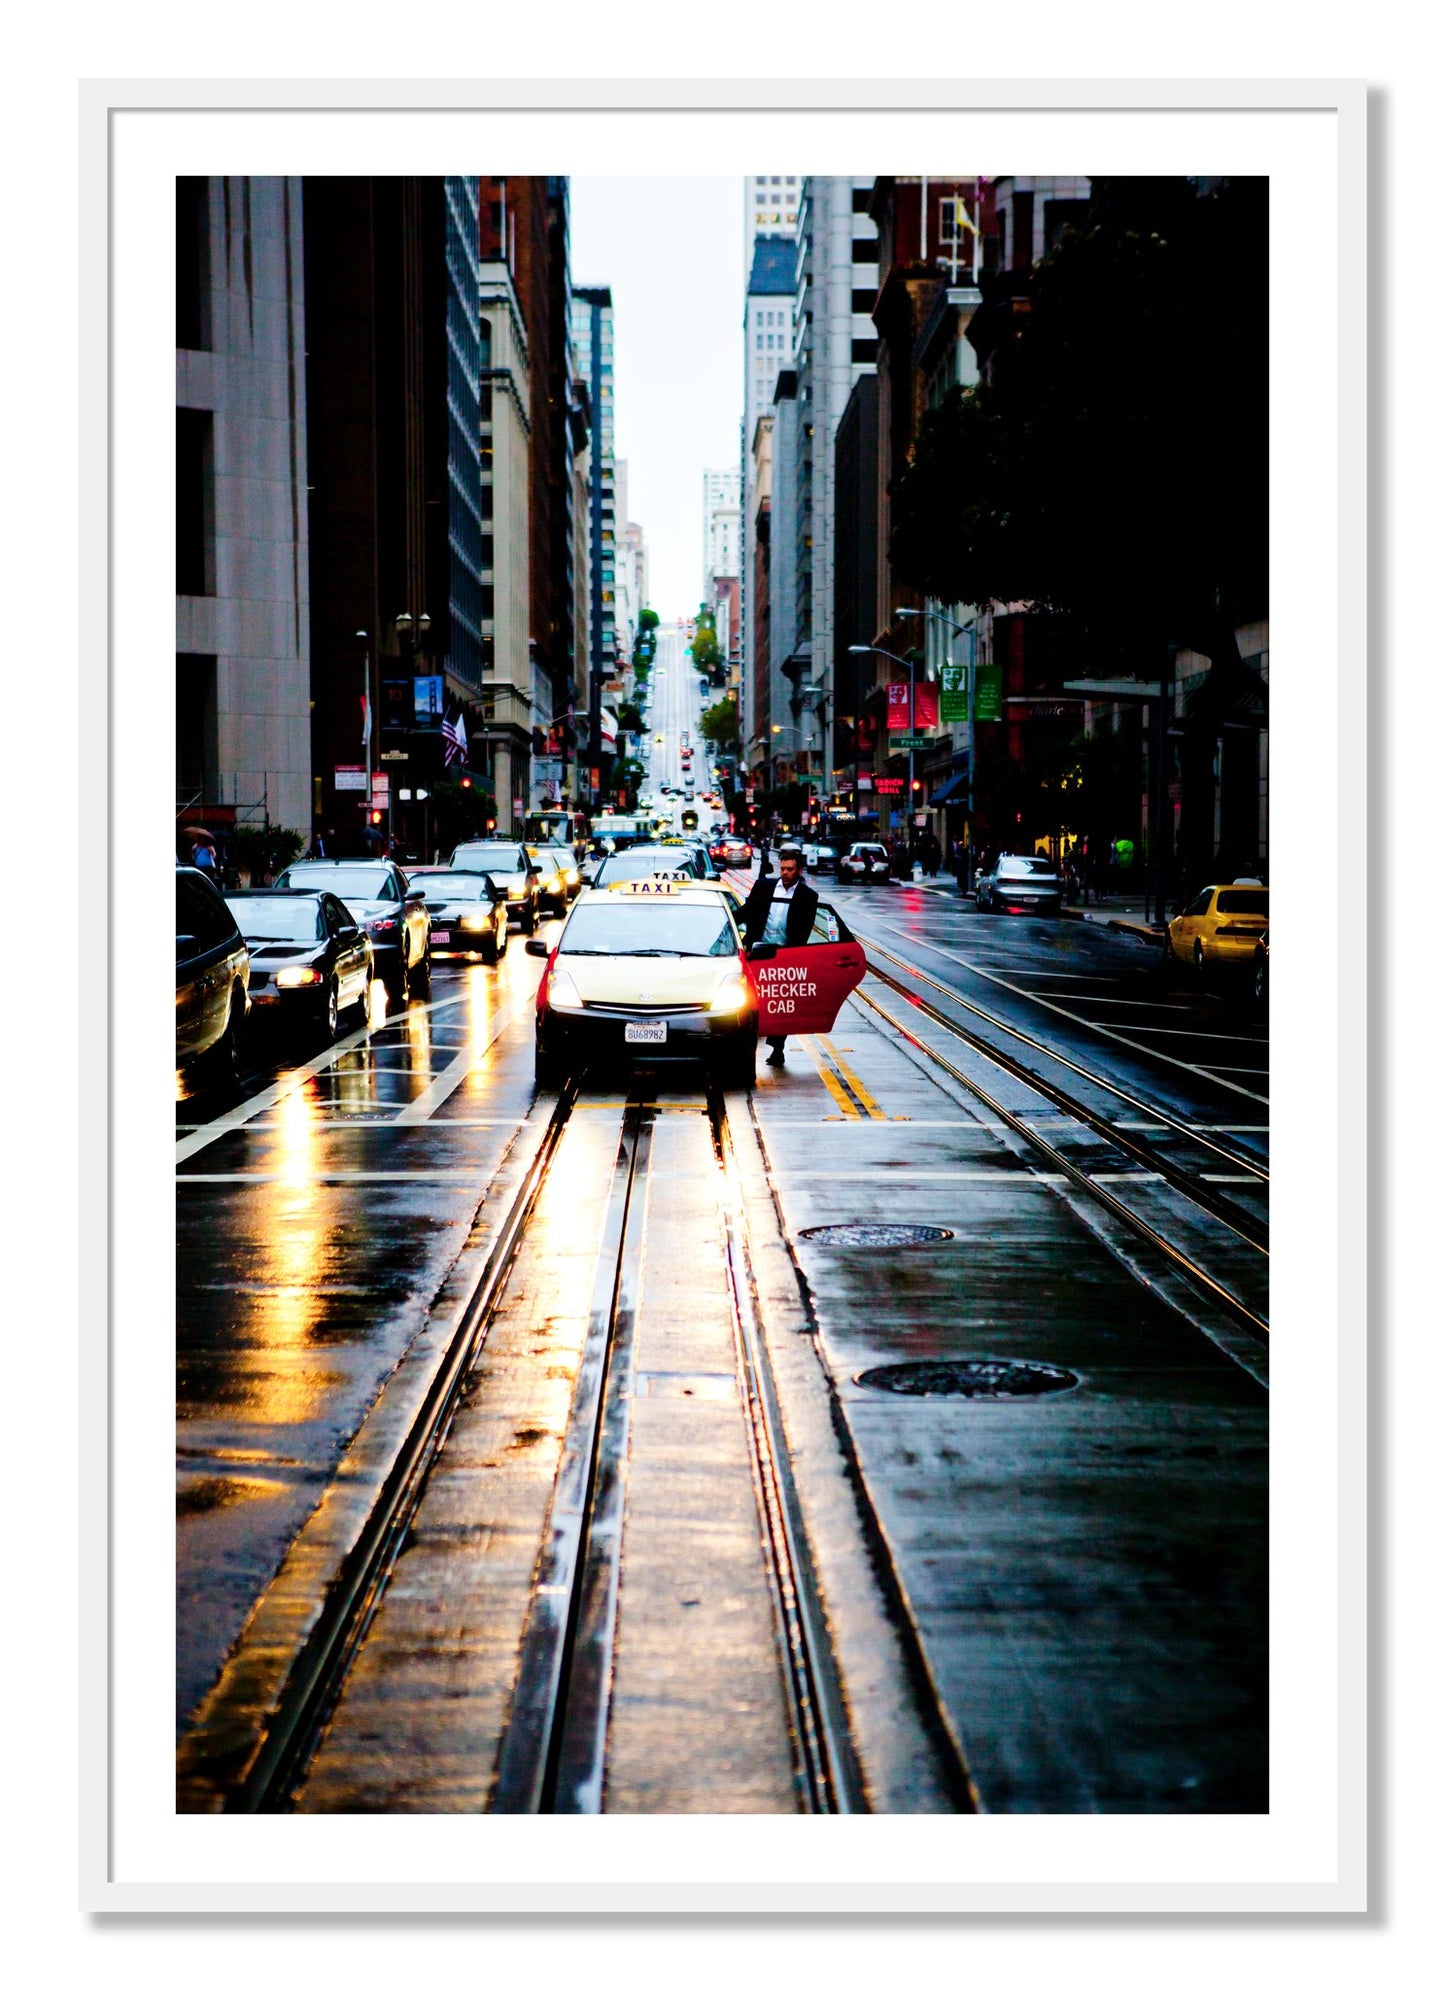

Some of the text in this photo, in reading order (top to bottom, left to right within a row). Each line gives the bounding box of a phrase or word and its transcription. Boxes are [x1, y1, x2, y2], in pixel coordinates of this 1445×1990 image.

[653, 872, 686, 881] TAXI
[631, 883, 671, 894] TAXI
[758, 967, 808, 982] ARROW
[767, 999, 796, 1014] CAB
